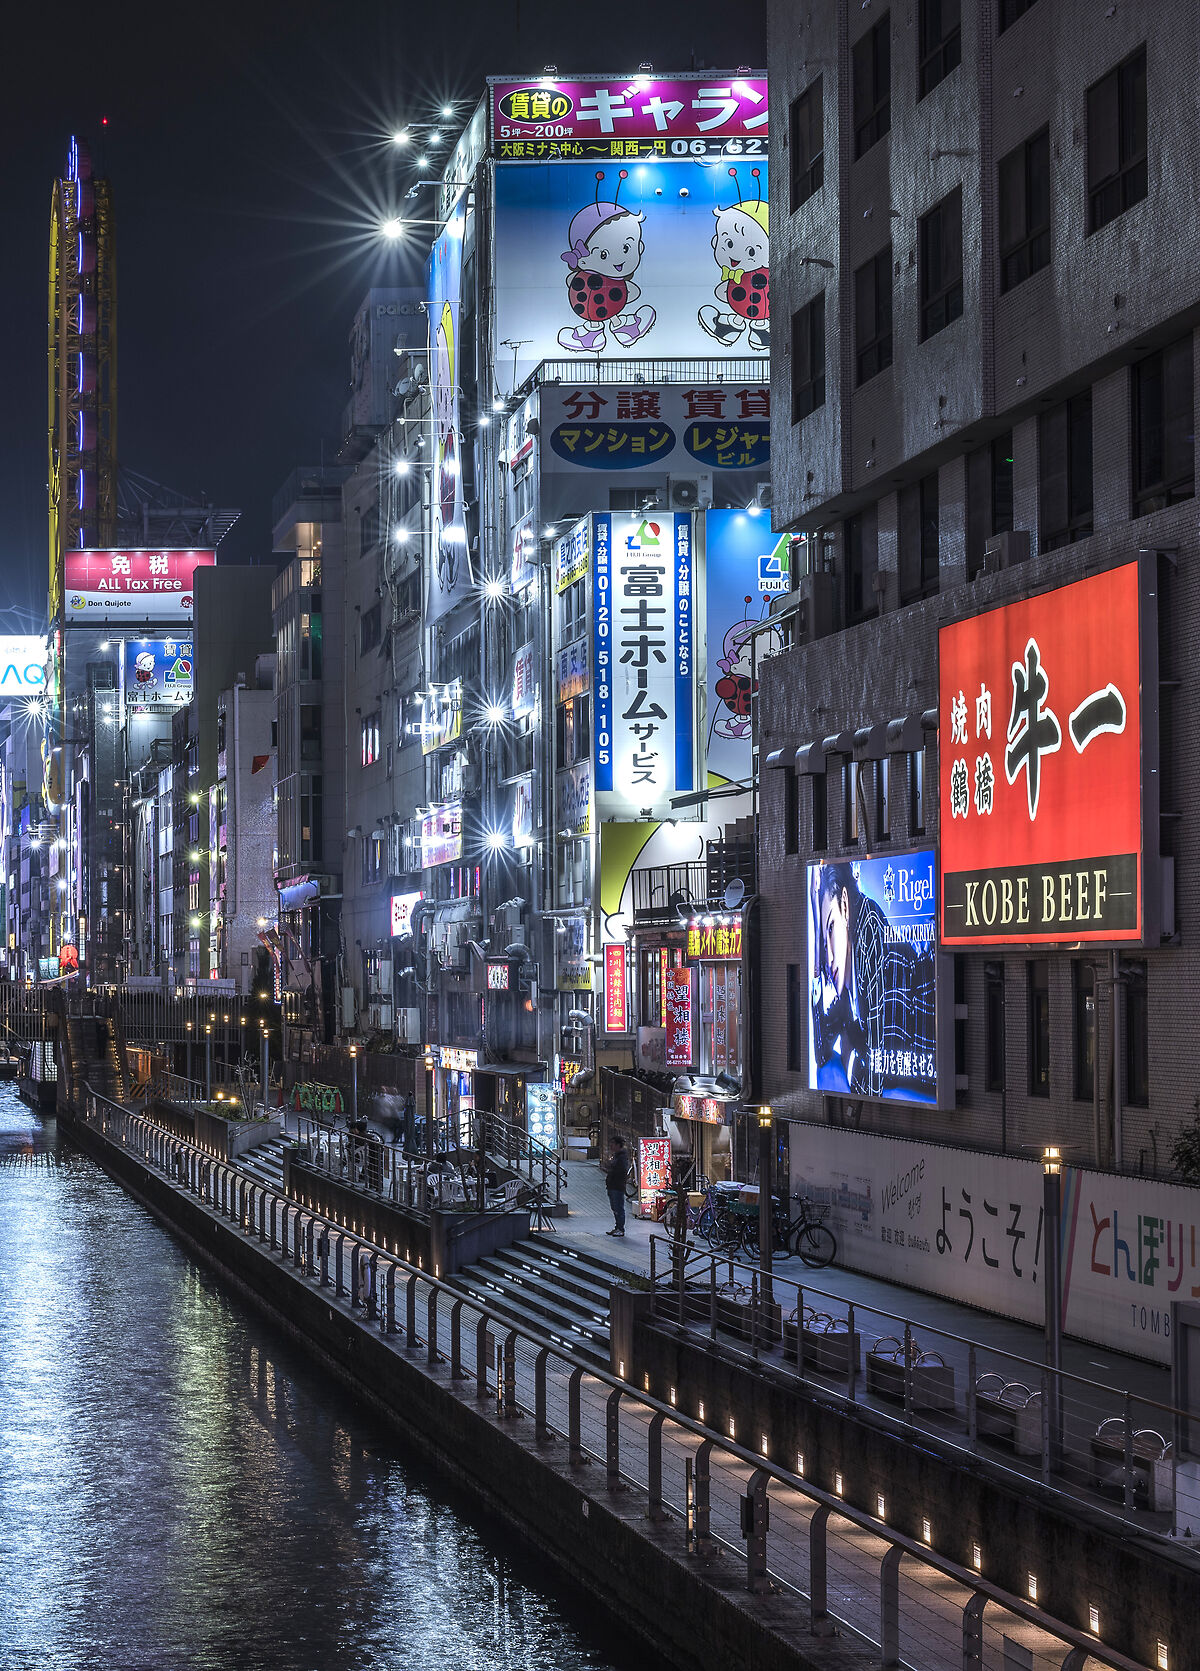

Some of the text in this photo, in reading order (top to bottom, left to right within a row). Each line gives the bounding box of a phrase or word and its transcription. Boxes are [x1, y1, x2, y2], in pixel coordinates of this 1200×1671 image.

[509, 92, 569, 119] 賃貸の
[575, 84, 768, 133] ギャラン
[671, 139, 768, 155] 06-62
[563, 389, 770, 420] 分譲 賃貸
[559, 428, 670, 453] マンション
[693, 427, 770, 452] レジャ
[717, 453, 757, 466] ビル
[97, 578, 183, 590] ALL Tax Free
[759, 580, 781, 591] FUJI
[88, 600, 132, 609] Don Quijote
[618, 564, 668, 785] 富士ホームサービス
[1005, 637, 1126, 821] 牛一
[898, 865, 935, 910] Rigel
[965, 869, 1108, 926] KOBE BEEF
[883, 922, 936, 944] HAYATO KIRIYA
[881, 1158, 926, 1214] Welcome
[1131, 1304, 1171, 1338] TOMB
